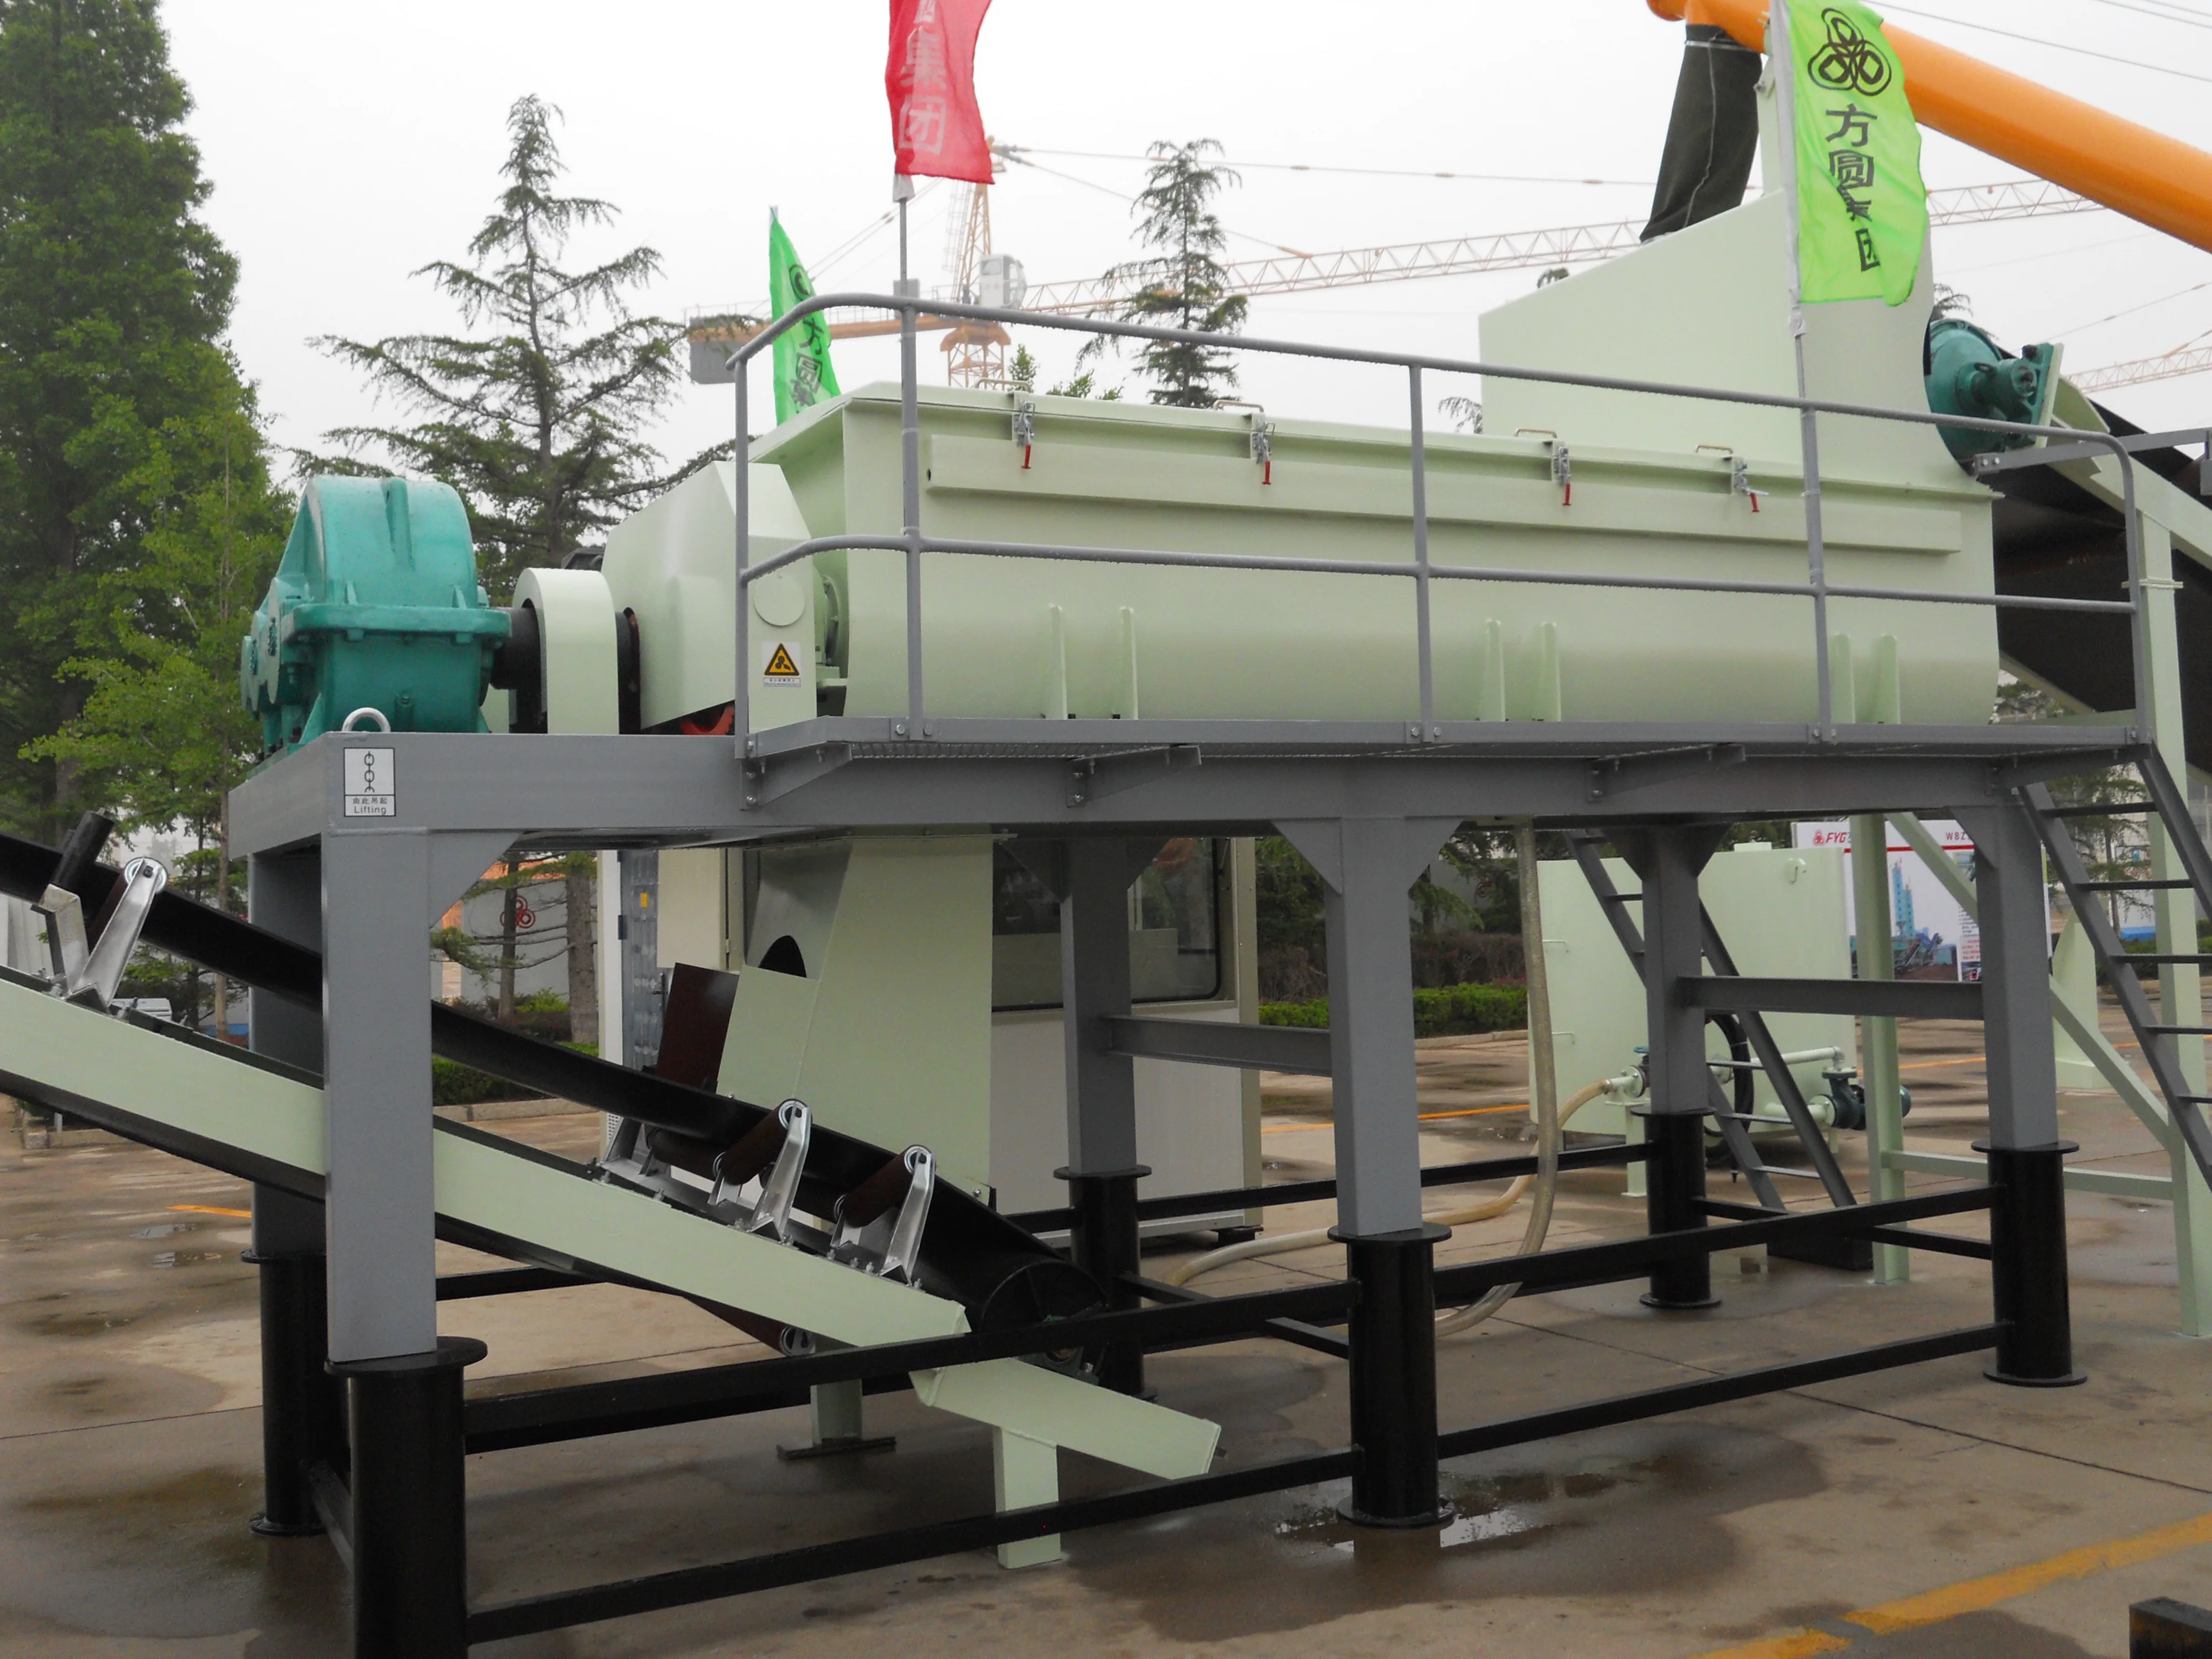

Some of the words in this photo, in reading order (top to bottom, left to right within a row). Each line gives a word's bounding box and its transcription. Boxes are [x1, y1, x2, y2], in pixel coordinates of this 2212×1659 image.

[354, 806, 387, 815] Lifting
[1825, 831, 1848, 843] FYG
[1945, 831, 1970, 841] WBZ
